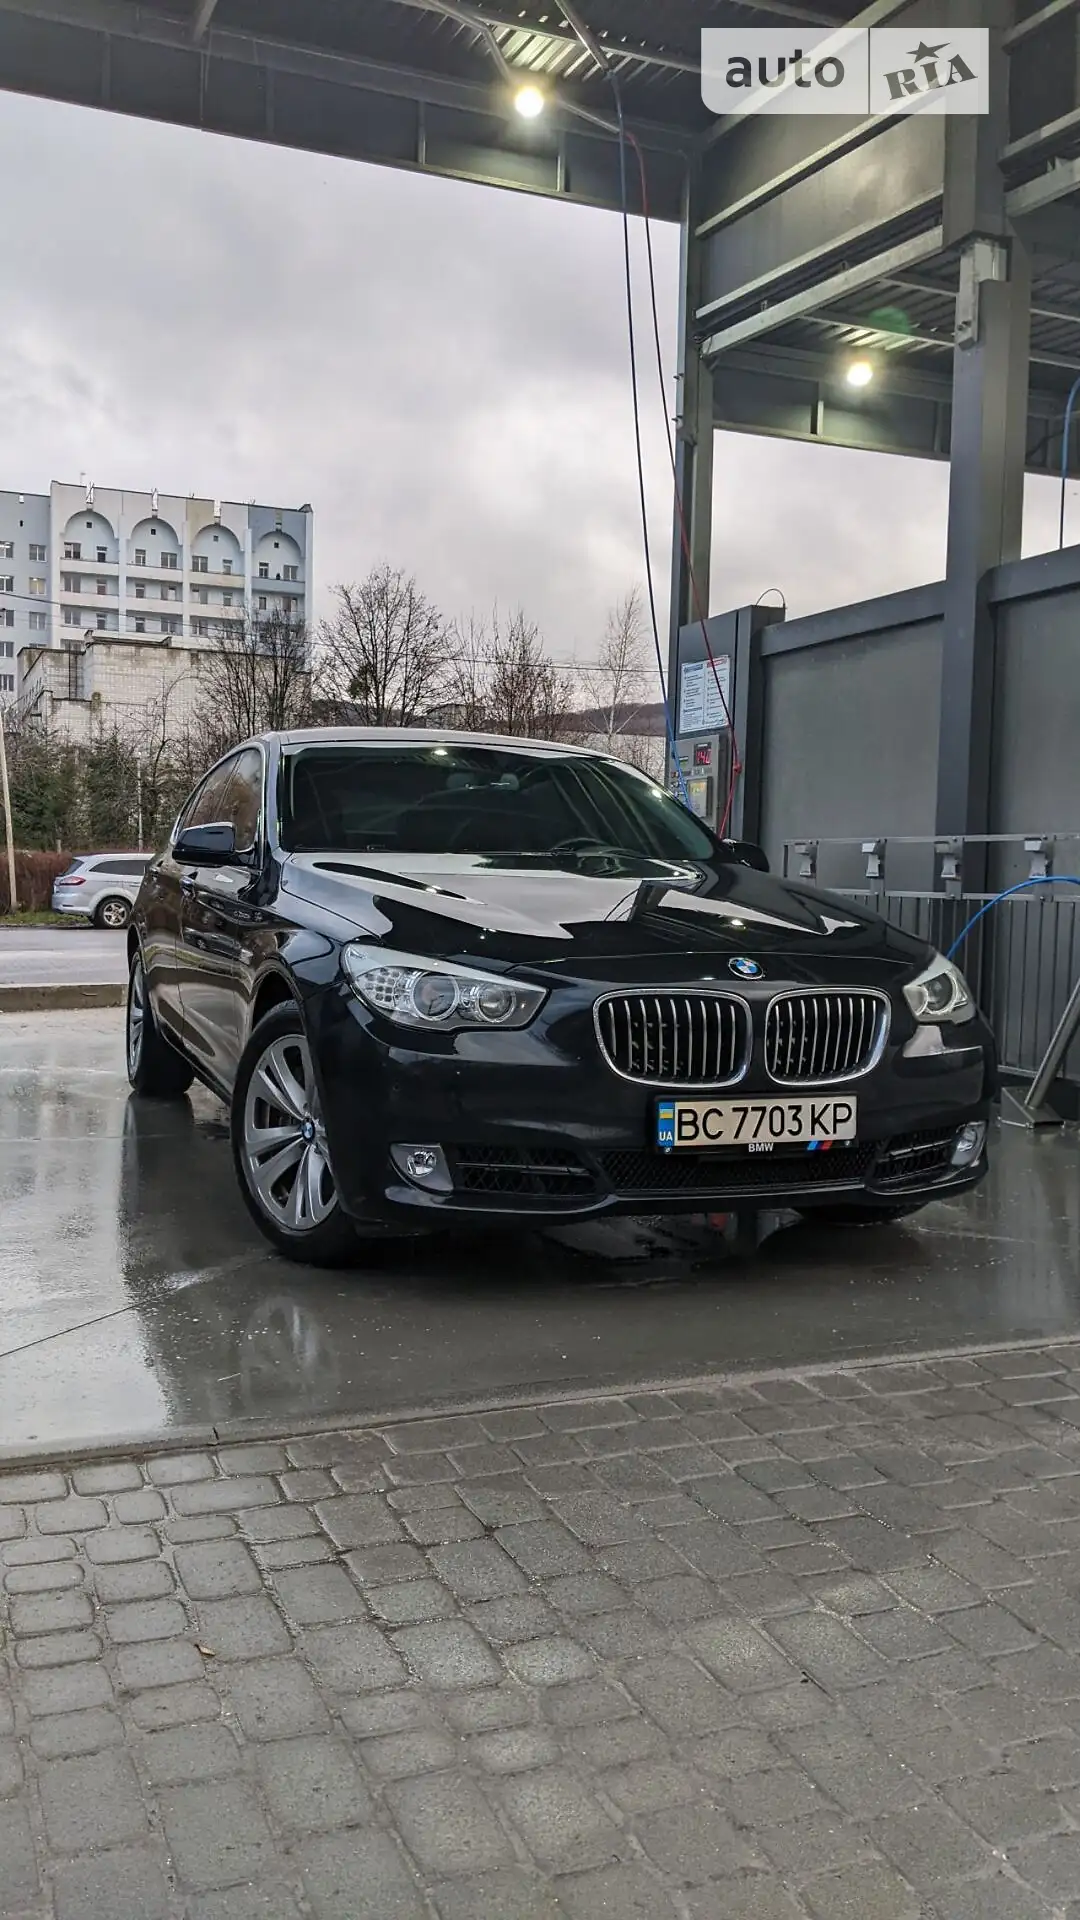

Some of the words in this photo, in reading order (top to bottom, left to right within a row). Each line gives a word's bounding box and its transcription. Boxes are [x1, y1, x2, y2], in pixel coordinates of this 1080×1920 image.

[677, 1108, 723, 1141] BC
[731, 1105, 803, 1140] 7703
[810, 1102, 852, 1136] KP
[659, 1132, 673, 1142] UA
[748, 1142, 774, 1153] BMW
